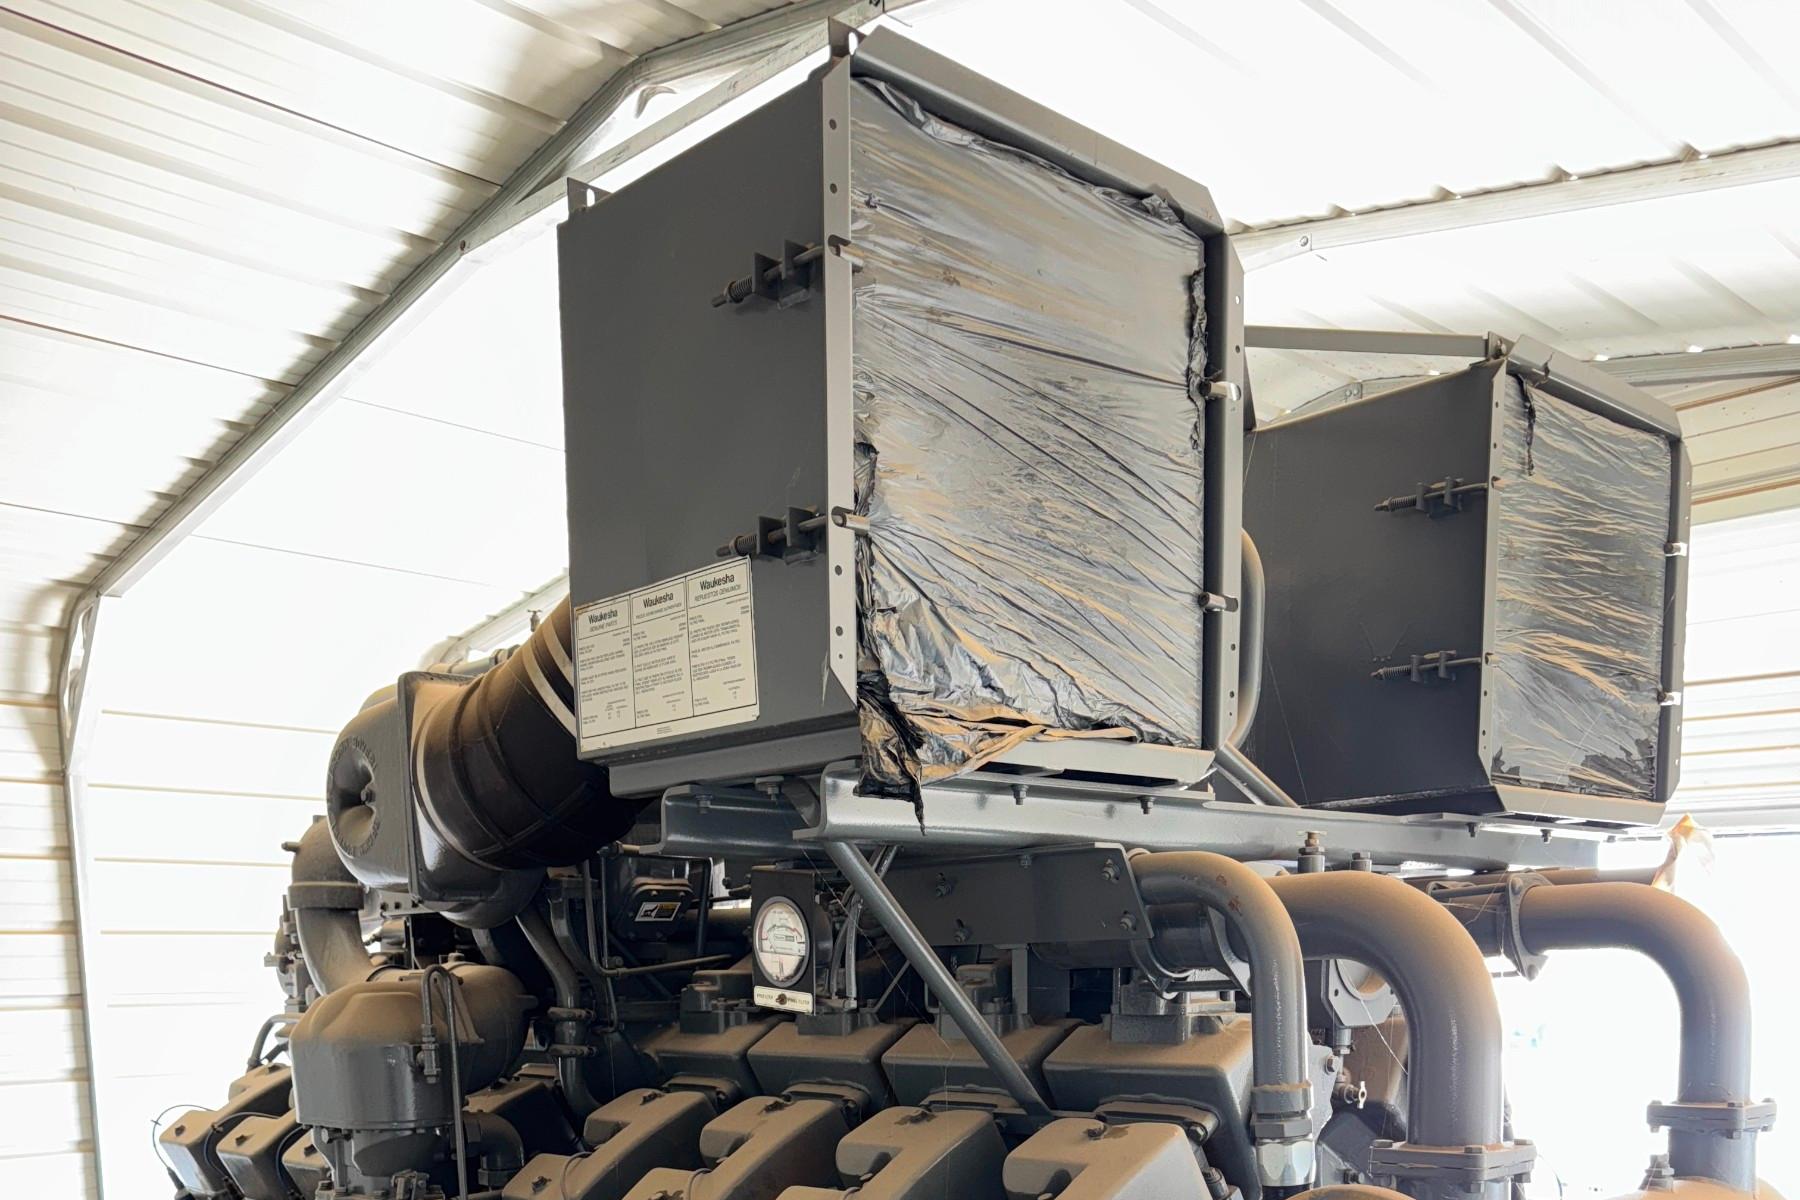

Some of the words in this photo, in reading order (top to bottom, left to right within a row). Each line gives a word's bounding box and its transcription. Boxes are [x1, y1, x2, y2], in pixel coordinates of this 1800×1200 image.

[699, 573, 735, 591] Waukesha
[643, 592, 674, 608] Waukesha
[588, 609, 618, 624] Waukesha
